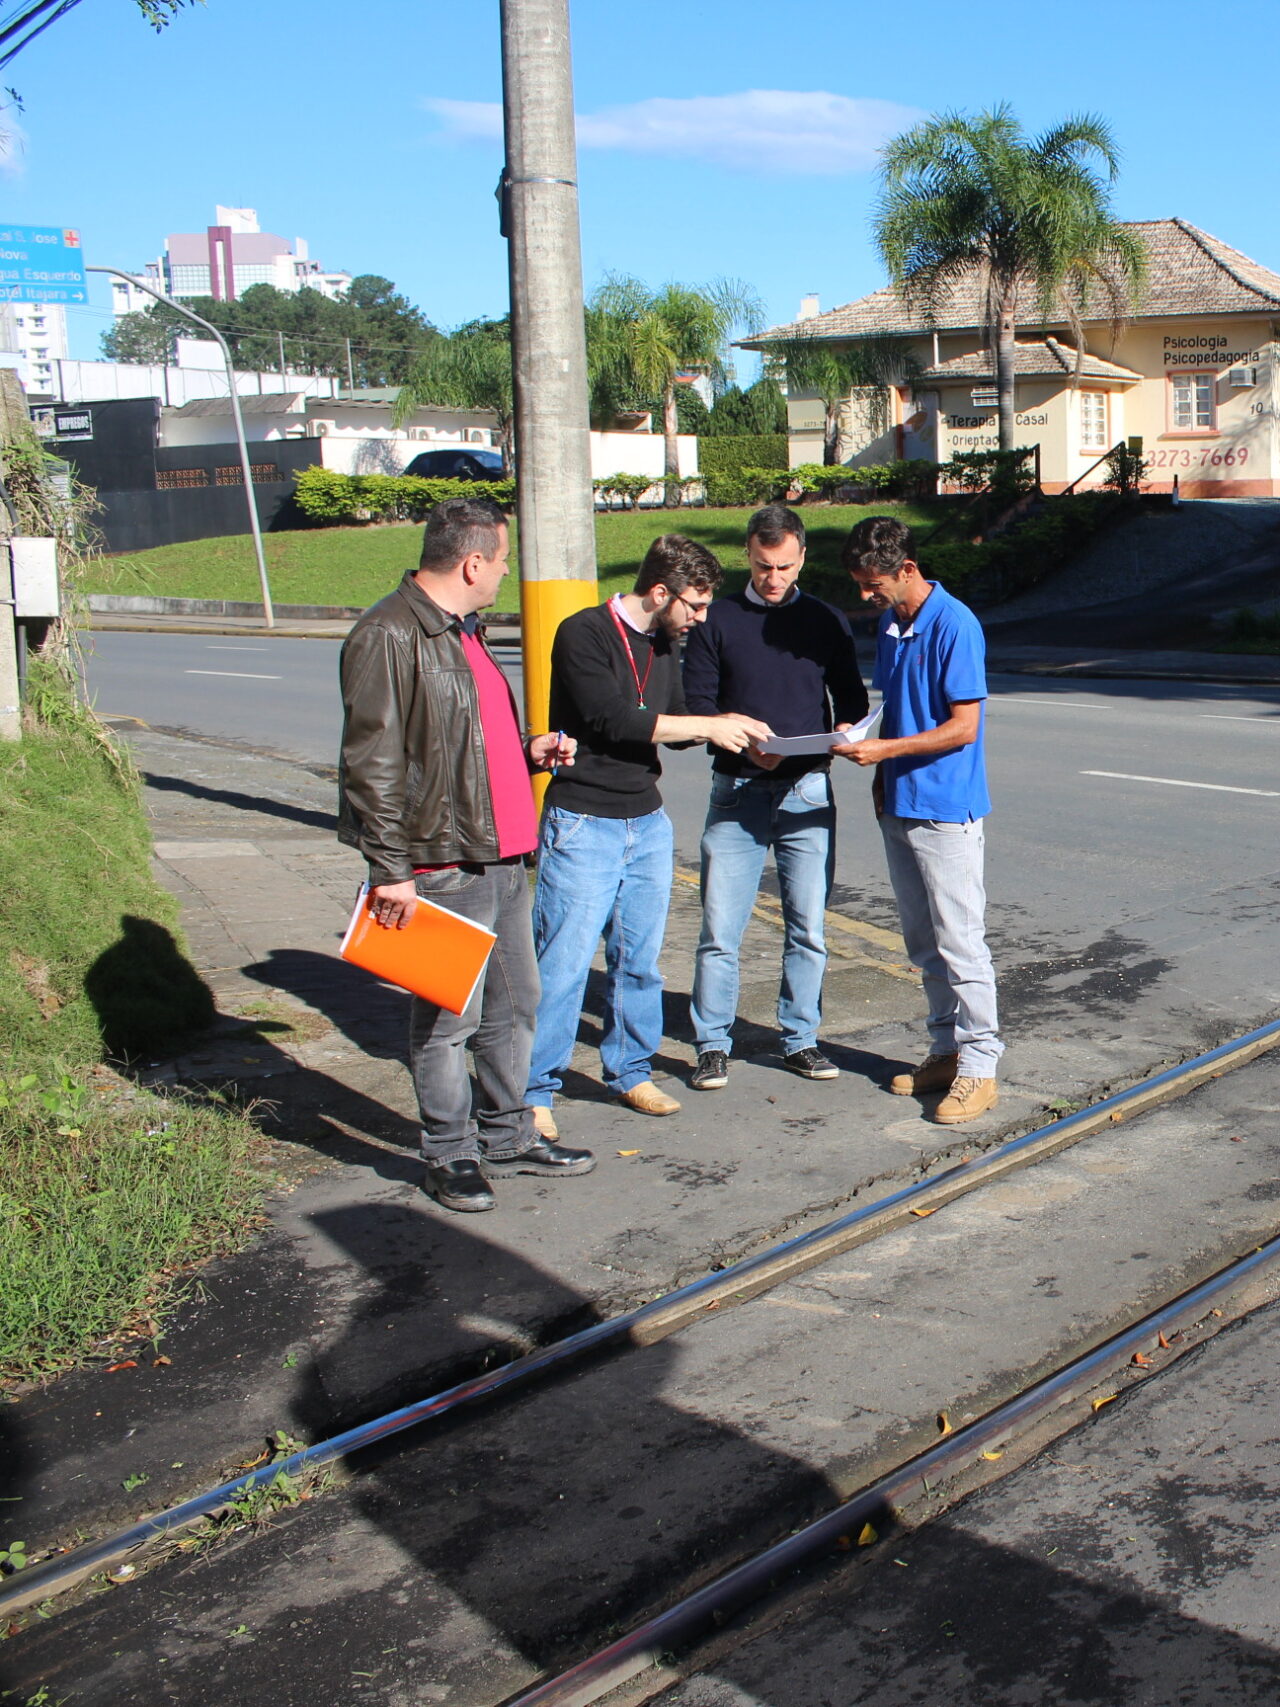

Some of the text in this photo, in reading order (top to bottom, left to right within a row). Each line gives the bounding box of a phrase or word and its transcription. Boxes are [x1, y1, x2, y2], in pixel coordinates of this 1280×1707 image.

[1163, 335, 1227, 350] Psicologia
[1164, 349, 1259, 366] Psicopedagogia
[57, 415, 90, 430] EMPREGOS
[950, 413, 1048, 429] Terapia Casal
[1146, 447, 1249, 467] 3273-7669
